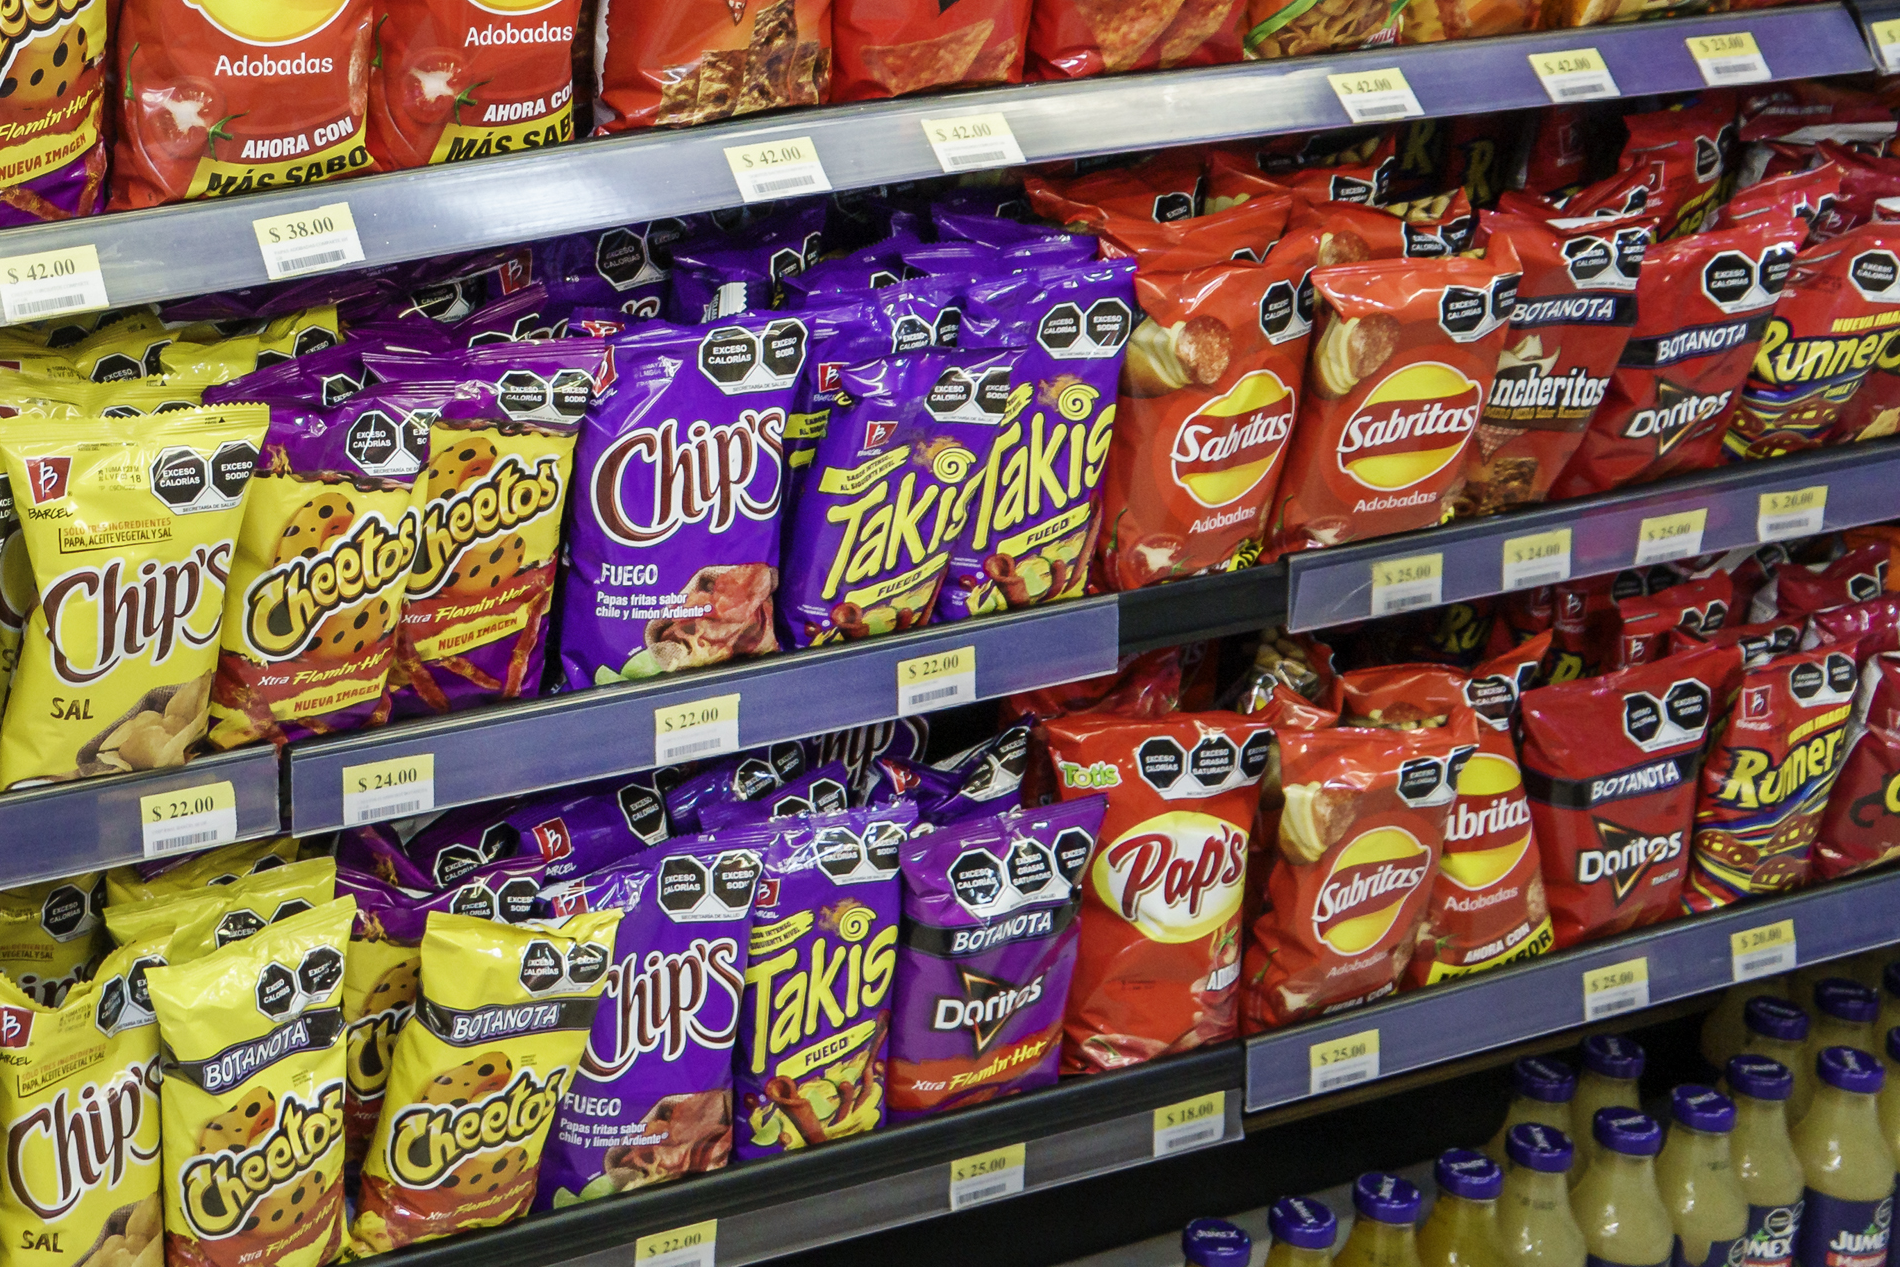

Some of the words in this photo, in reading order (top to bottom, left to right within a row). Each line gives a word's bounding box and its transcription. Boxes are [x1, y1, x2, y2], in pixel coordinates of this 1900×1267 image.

[464, 22, 573, 48] Adobadas
[214, 53, 334, 78] Adobadas
[43, 133, 88, 169] IMAGEN
[241, 132, 309, 160] AHORA
[313, 116, 355, 146] CON
[742, 155, 754, 168] $
[759, 145, 800, 165] 42.00
[268, 228, 281, 243] $
[286, 217, 334, 240] 38.00
[7, 269, 19, 284] $
[26, 259, 75, 281] 42.00
[1510, 298, 1615, 322] BOTANOTA
[1658, 323, 1748, 364] BOTANOTA
[1337, 402, 1478, 453] Sabritas
[1626, 389, 1733, 438] Doritos
[1170, 409, 1293, 466] Sabritas
[973, 384, 1116, 550] Takis
[1354, 489, 1437, 513] Adobadas
[824, 446, 978, 601] Takis
[1190, 505, 1256, 534] Adobadas
[248, 528, 418, 654] Cheetos
[601, 562, 658, 587] FUEGO
[596, 605, 621, 619] chile
[631, 605, 661, 620] limón
[50, 696, 94, 721] SAL
[665, 720, 673, 730] $
[679, 707, 719, 729] 22.00
[358, 779, 368, 791] $
[374, 768, 417, 790] 24.00
[1061, 761, 1121, 788] Totis
[1590, 761, 1681, 801] BOTANOTA
[152, 807, 162, 821] $
[169, 796, 214, 819] 22.00
[1109, 824, 1248, 921] Pap's
[1579, 832, 1682, 883] Doritos
[1312, 859, 1426, 923] Sabritas
[1445, 885, 1518, 913] Adobadas
[952, 911, 1051, 953] BOTANOTA
[746, 907, 899, 1075] Takis
[934, 976, 1043, 1032] Doritos
[453, 1002, 559, 1040] BOTANOTA
[203, 1021, 307, 1090] BOTANOTA
[804, 1036, 850, 1067] FUEGO
[564, 1092, 622, 1117] FUEGO
[396, 1069, 566, 1185] Cheetos
[185, 1084, 344, 1236] Cheetos
[20, 1231, 63, 1254] SAL
[648, 1246, 656, 1256] $
[662, 1233, 701, 1254] 22.00
